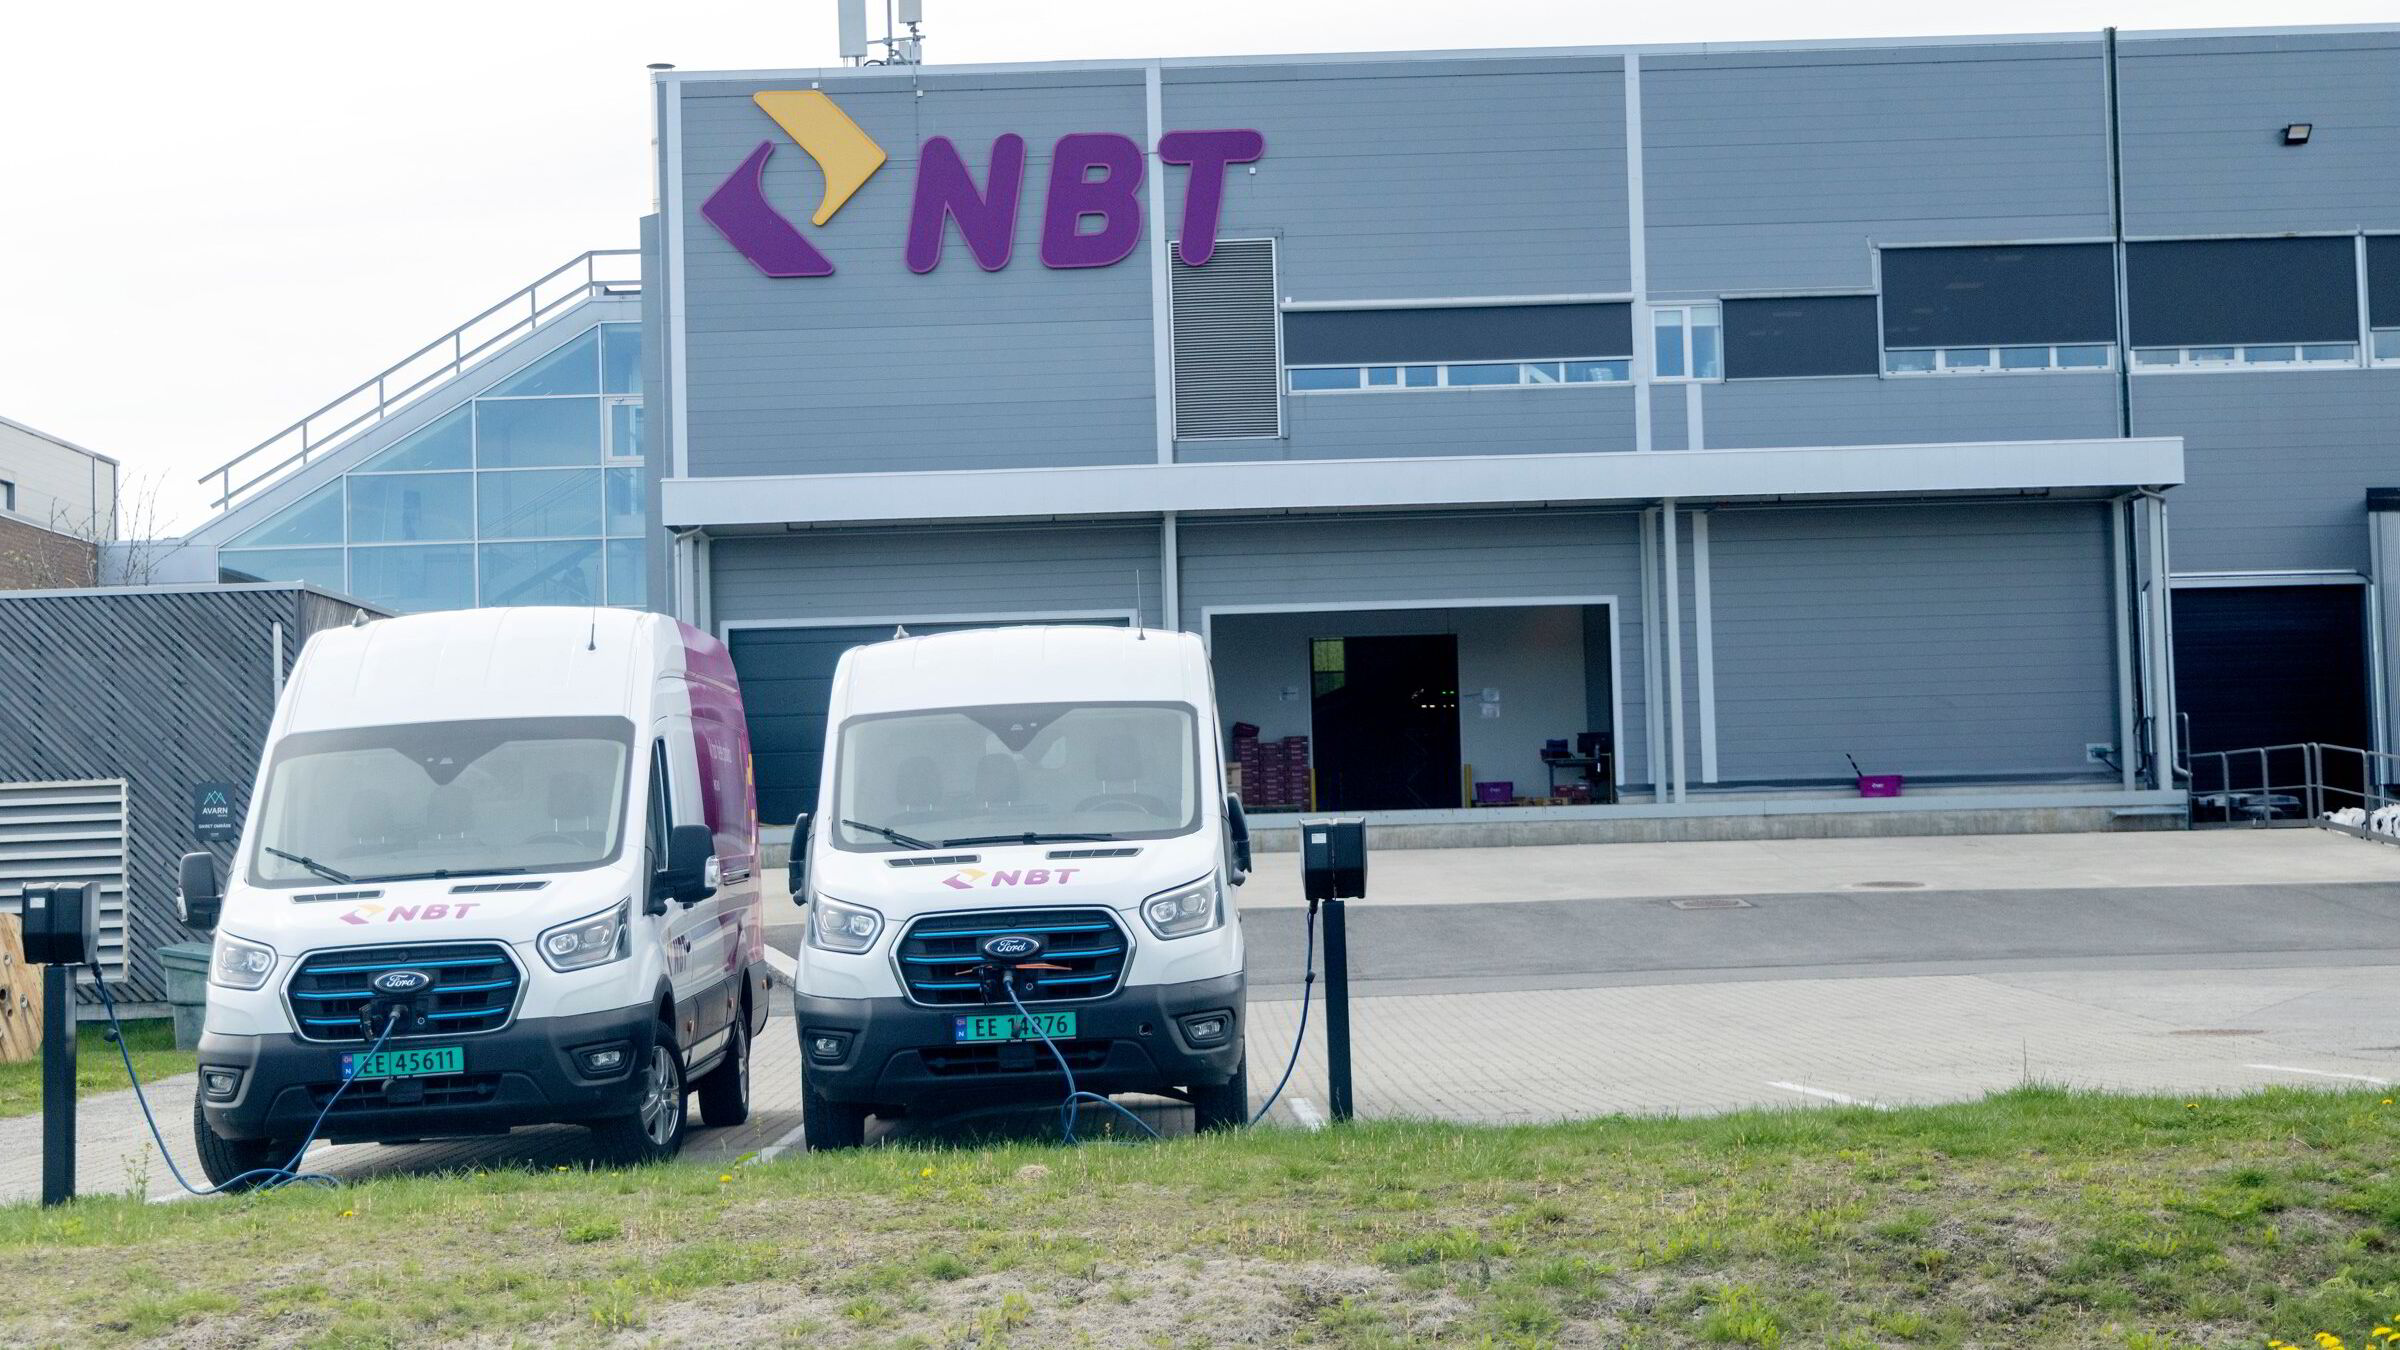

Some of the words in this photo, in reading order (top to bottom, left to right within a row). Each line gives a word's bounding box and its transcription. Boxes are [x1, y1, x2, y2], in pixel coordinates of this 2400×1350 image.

[905, 129, 1264, 273] NBT
[990, 868, 1080, 887] NBT
[386, 902, 481, 922] NBT
[996, 939, 1026, 953] Ford
[386, 974, 416, 988] Ford
[975, 1018, 998, 1037] EE
[1007, 1014, 1069, 1038] 14876
[362, 1055, 385, 1074] EE
[395, 1050, 455, 1072] 45611
